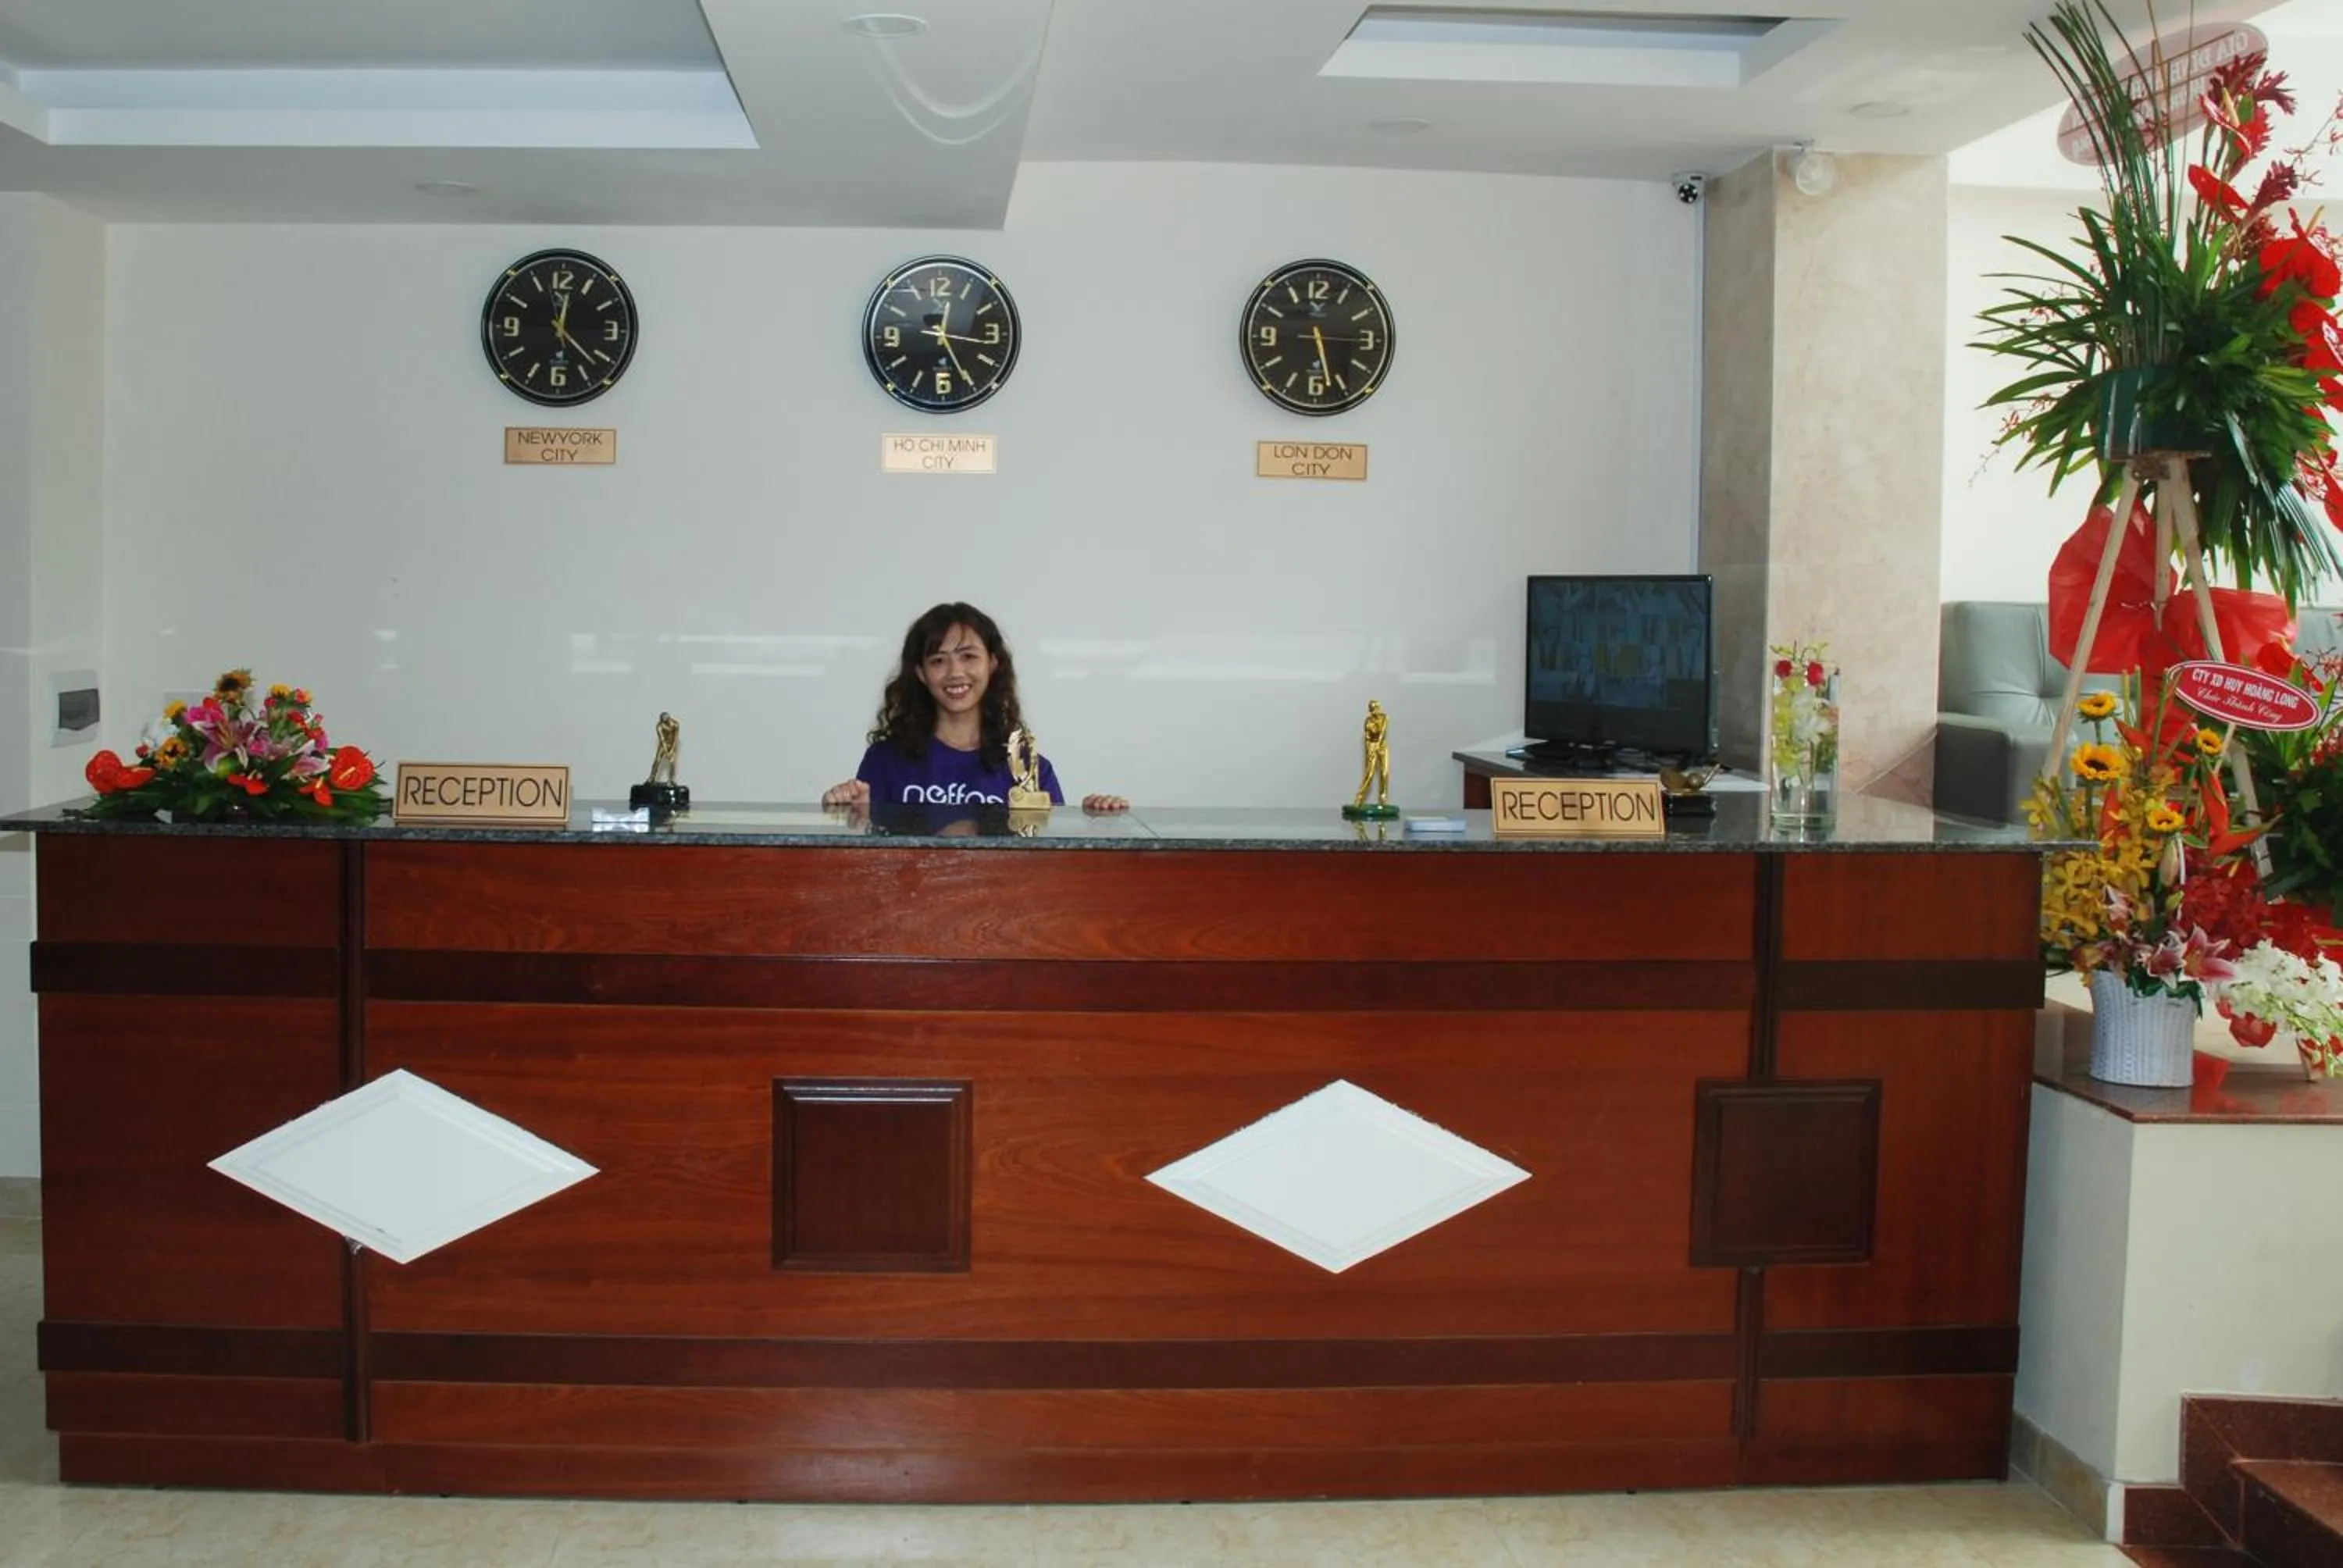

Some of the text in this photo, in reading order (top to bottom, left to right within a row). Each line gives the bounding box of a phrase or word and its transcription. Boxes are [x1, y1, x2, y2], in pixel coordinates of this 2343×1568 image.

[552, 272, 574, 290] 12
[930, 277, 952, 297] 12
[1308, 280, 1330, 299] 12
[504, 316, 519, 337] 9
[604, 321, 618, 340] 3
[884, 326, 900, 347] 9
[985, 323, 1000, 344] 3
[1261, 326, 1277, 346] 9
[1359, 330, 1374, 351] 3
[551, 366, 568, 387] 6
[936, 372, 952, 394] 6
[1308, 376, 1324, 396] 6
[518, 431, 603, 446] NEWYORK
[894, 439, 986, 453] HO CHI MINH
[540, 448, 579, 462] CITY
[922, 455, 954, 469] CITY
[1292, 462, 1330, 476] CITY
[2192, 668, 2212, 683] CTY
[2209, 672, 2224, 687] XD
[2224, 677, 2245, 693] HUY
[2274, 691, 2300, 709] LONG
[403, 775, 562, 807] RECEPTION
[1502, 790, 1657, 822] RECEPTION
